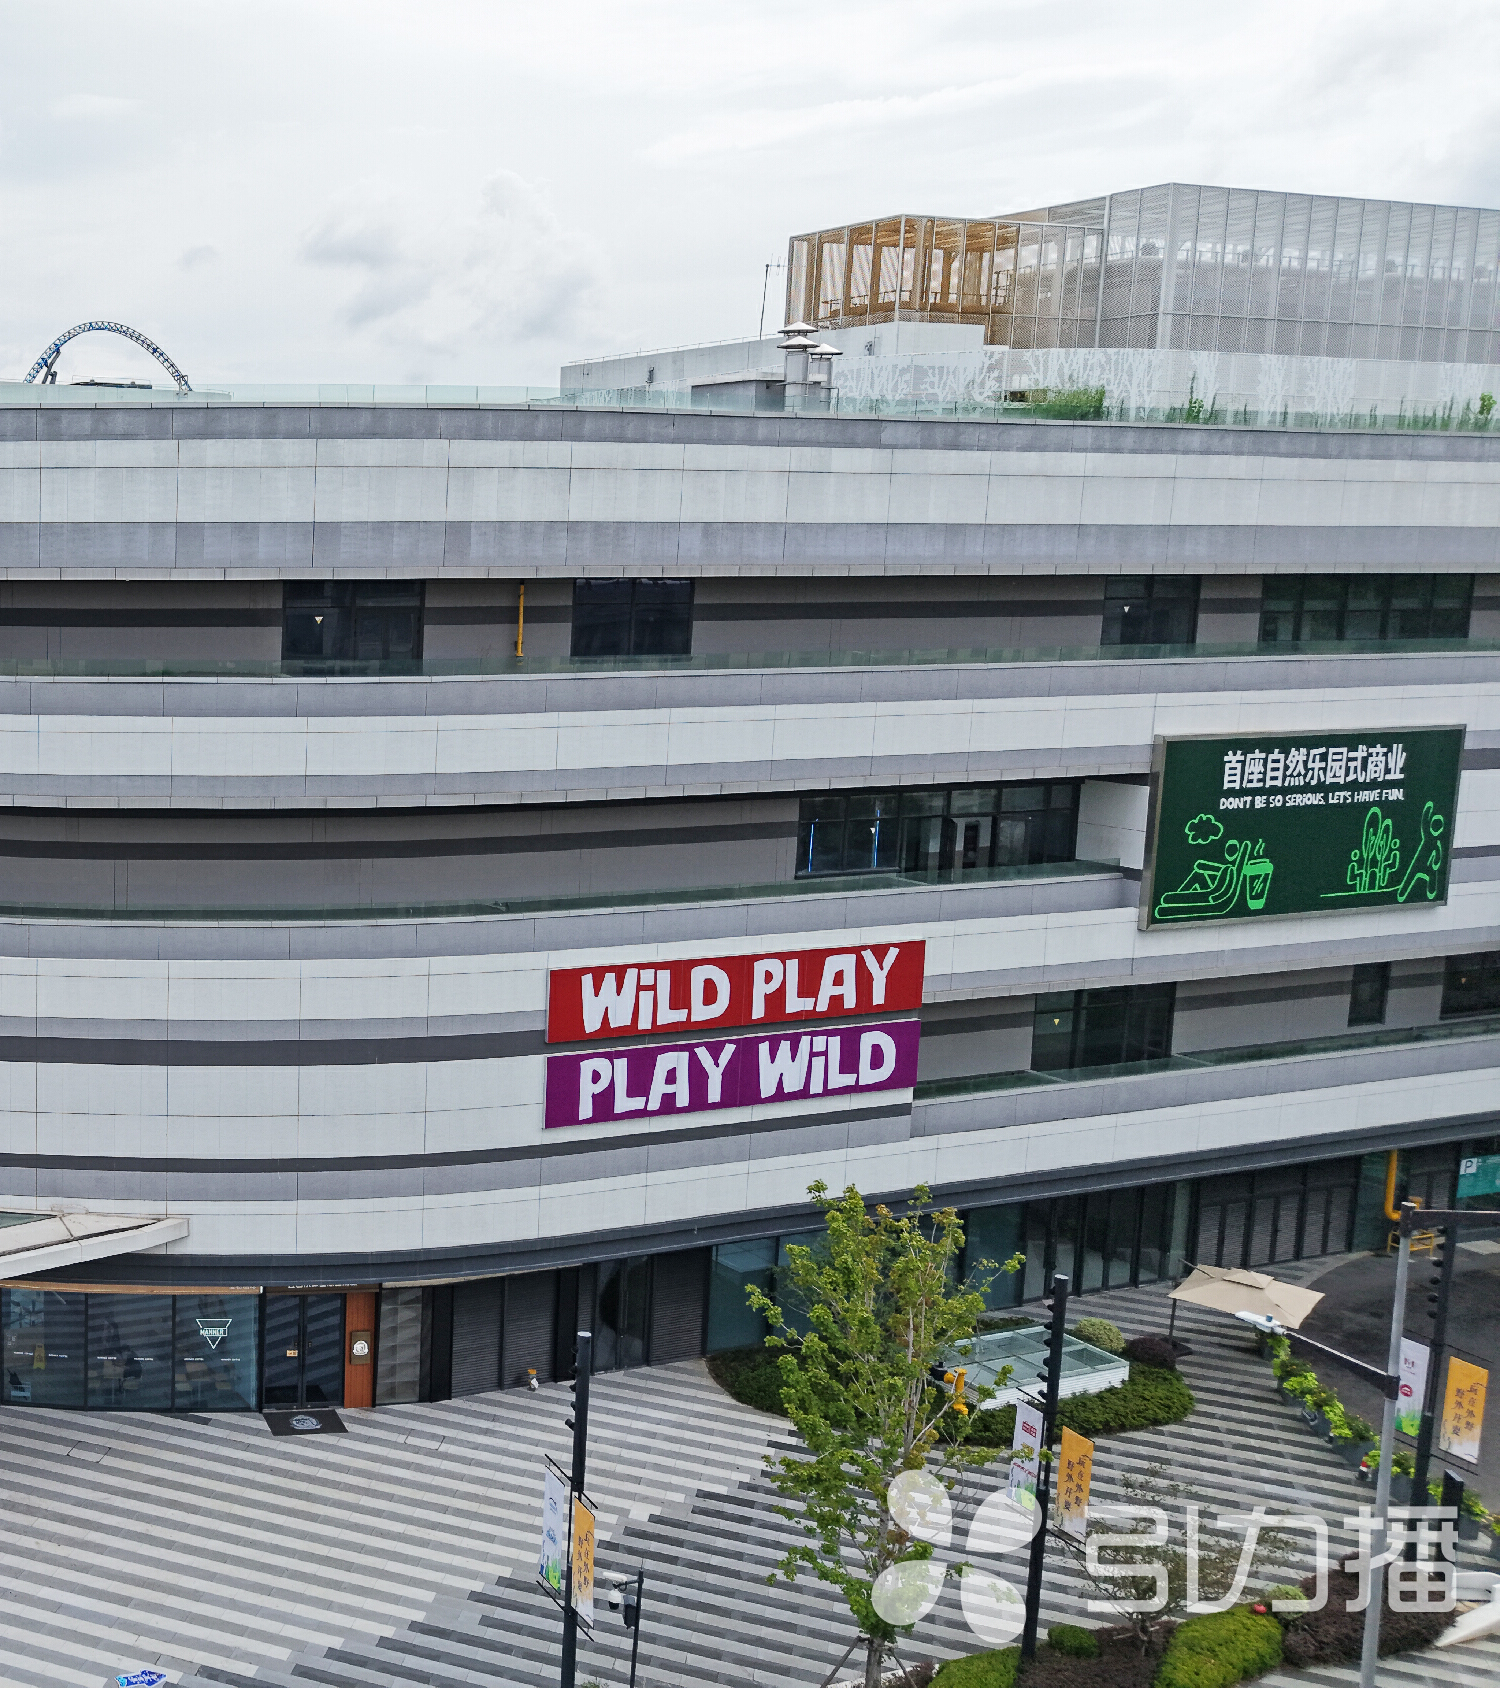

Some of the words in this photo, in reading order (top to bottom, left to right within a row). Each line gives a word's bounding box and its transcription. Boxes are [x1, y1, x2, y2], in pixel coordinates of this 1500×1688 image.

[1223, 743, 1406, 790] 首座自然乐园式商业
[1219, 796, 1252, 810] DON'T
[1254, 796, 1267, 808] BE
[1269, 795, 1283, 807] SO
[1328, 791, 1352, 804] LET'S
[1354, 789, 1381, 802] HAVE
[751, 947, 900, 1020] PLAY
[579, 1042, 737, 1121] PLAY
